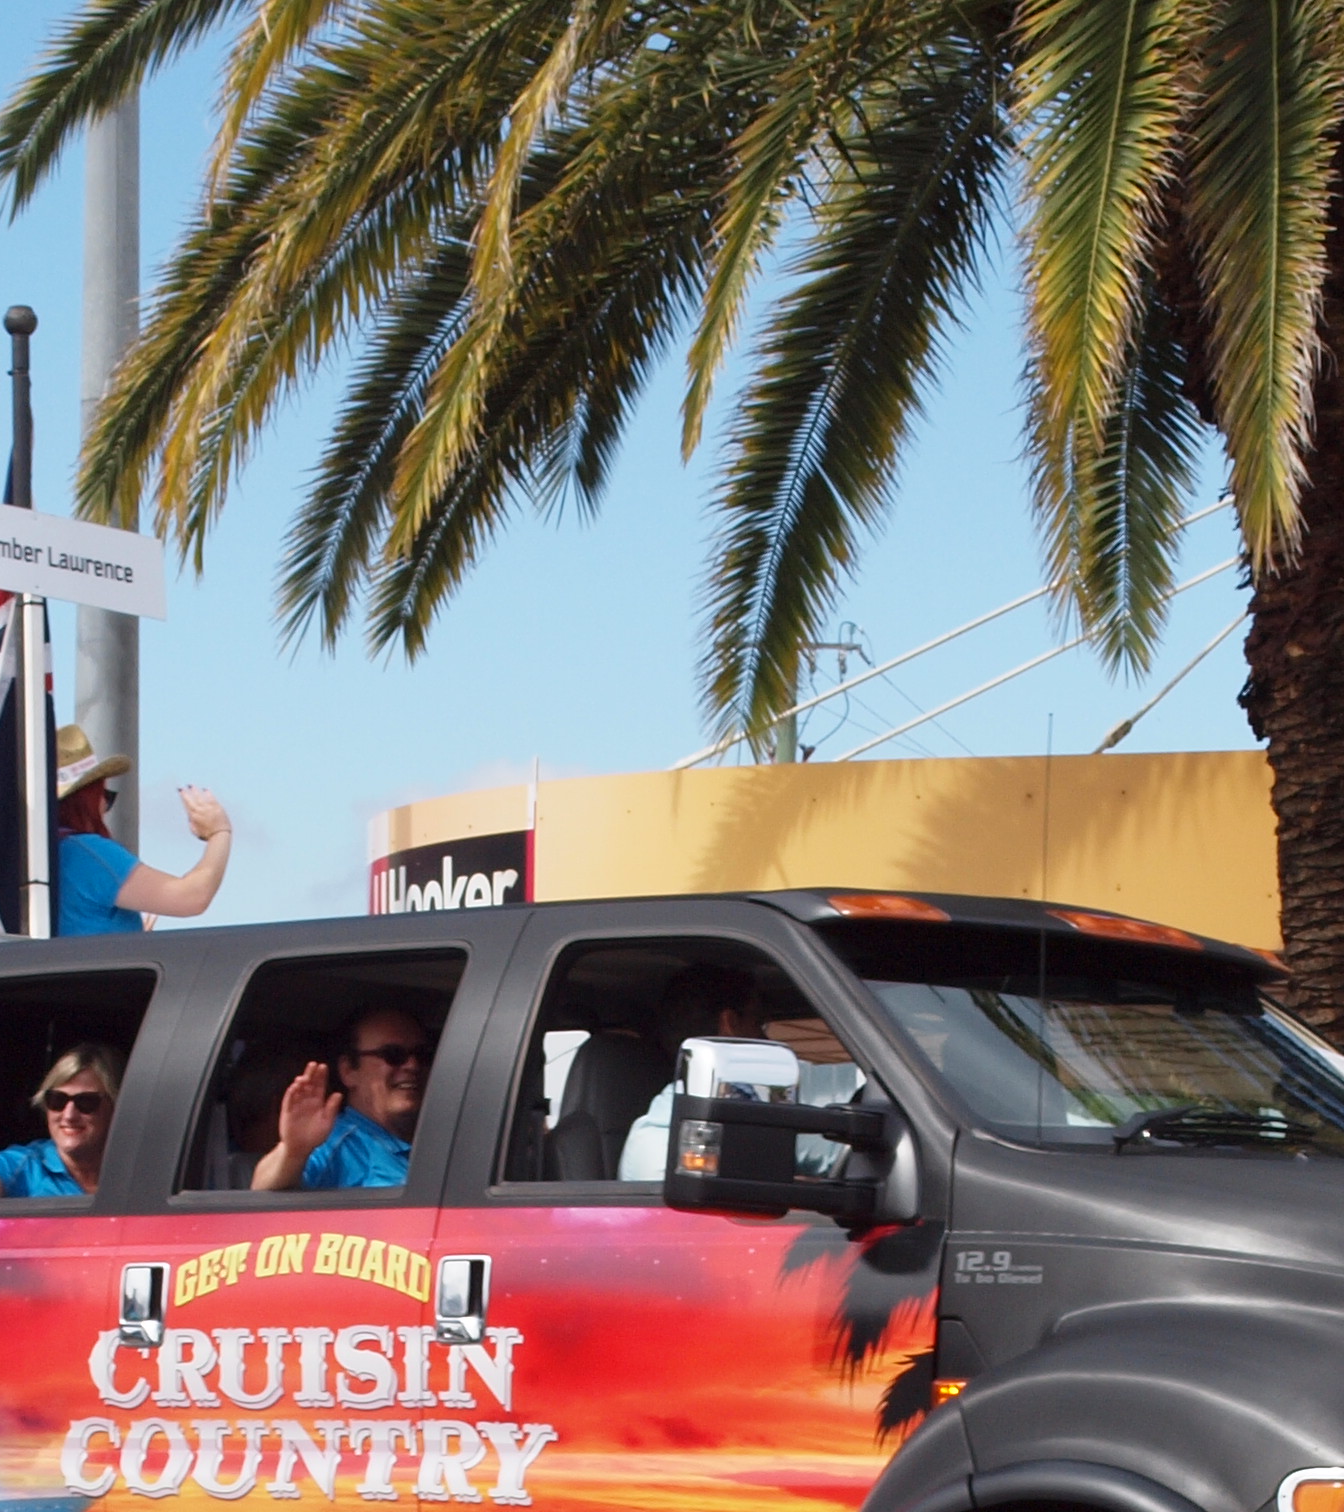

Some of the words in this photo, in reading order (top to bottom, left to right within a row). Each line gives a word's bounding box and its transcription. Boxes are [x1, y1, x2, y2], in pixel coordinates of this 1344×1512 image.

[47, 546, 134, 584] Lawrence
[174, 1242, 252, 1307] GET
[255, 1233, 311, 1278] ON
[313, 1233, 431, 1303] BOARD
[956, 1250, 1012, 1272] 12.9
[88, 1325, 524, 1411] CRUISIN
[60, 1416, 558, 1506] COUNTRY
